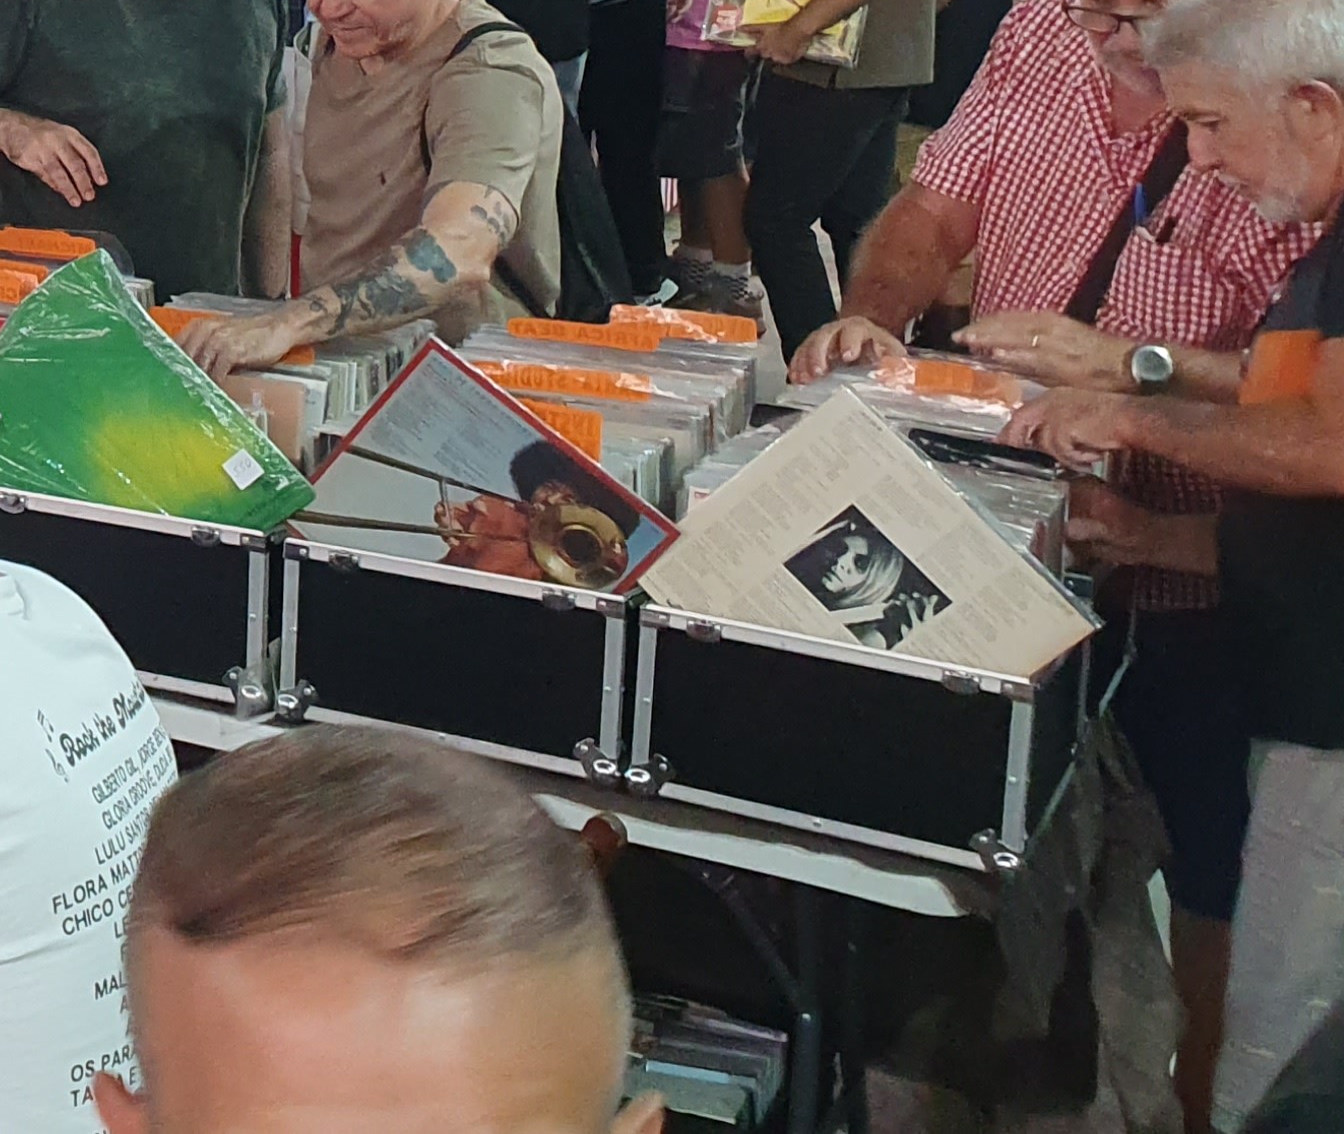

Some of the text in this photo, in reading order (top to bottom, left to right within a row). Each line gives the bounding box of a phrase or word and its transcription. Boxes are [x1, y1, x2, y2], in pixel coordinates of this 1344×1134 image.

[59, 732, 100, 767] Rock
[93, 712, 117, 742] the
[92, 765, 128, 804] GILBERTO
[94, 831, 126, 865] LULU
[52, 874, 108, 915] FLORA
[62, 898, 114, 936] CHICO
[70, 1060, 95, 1083] OS
